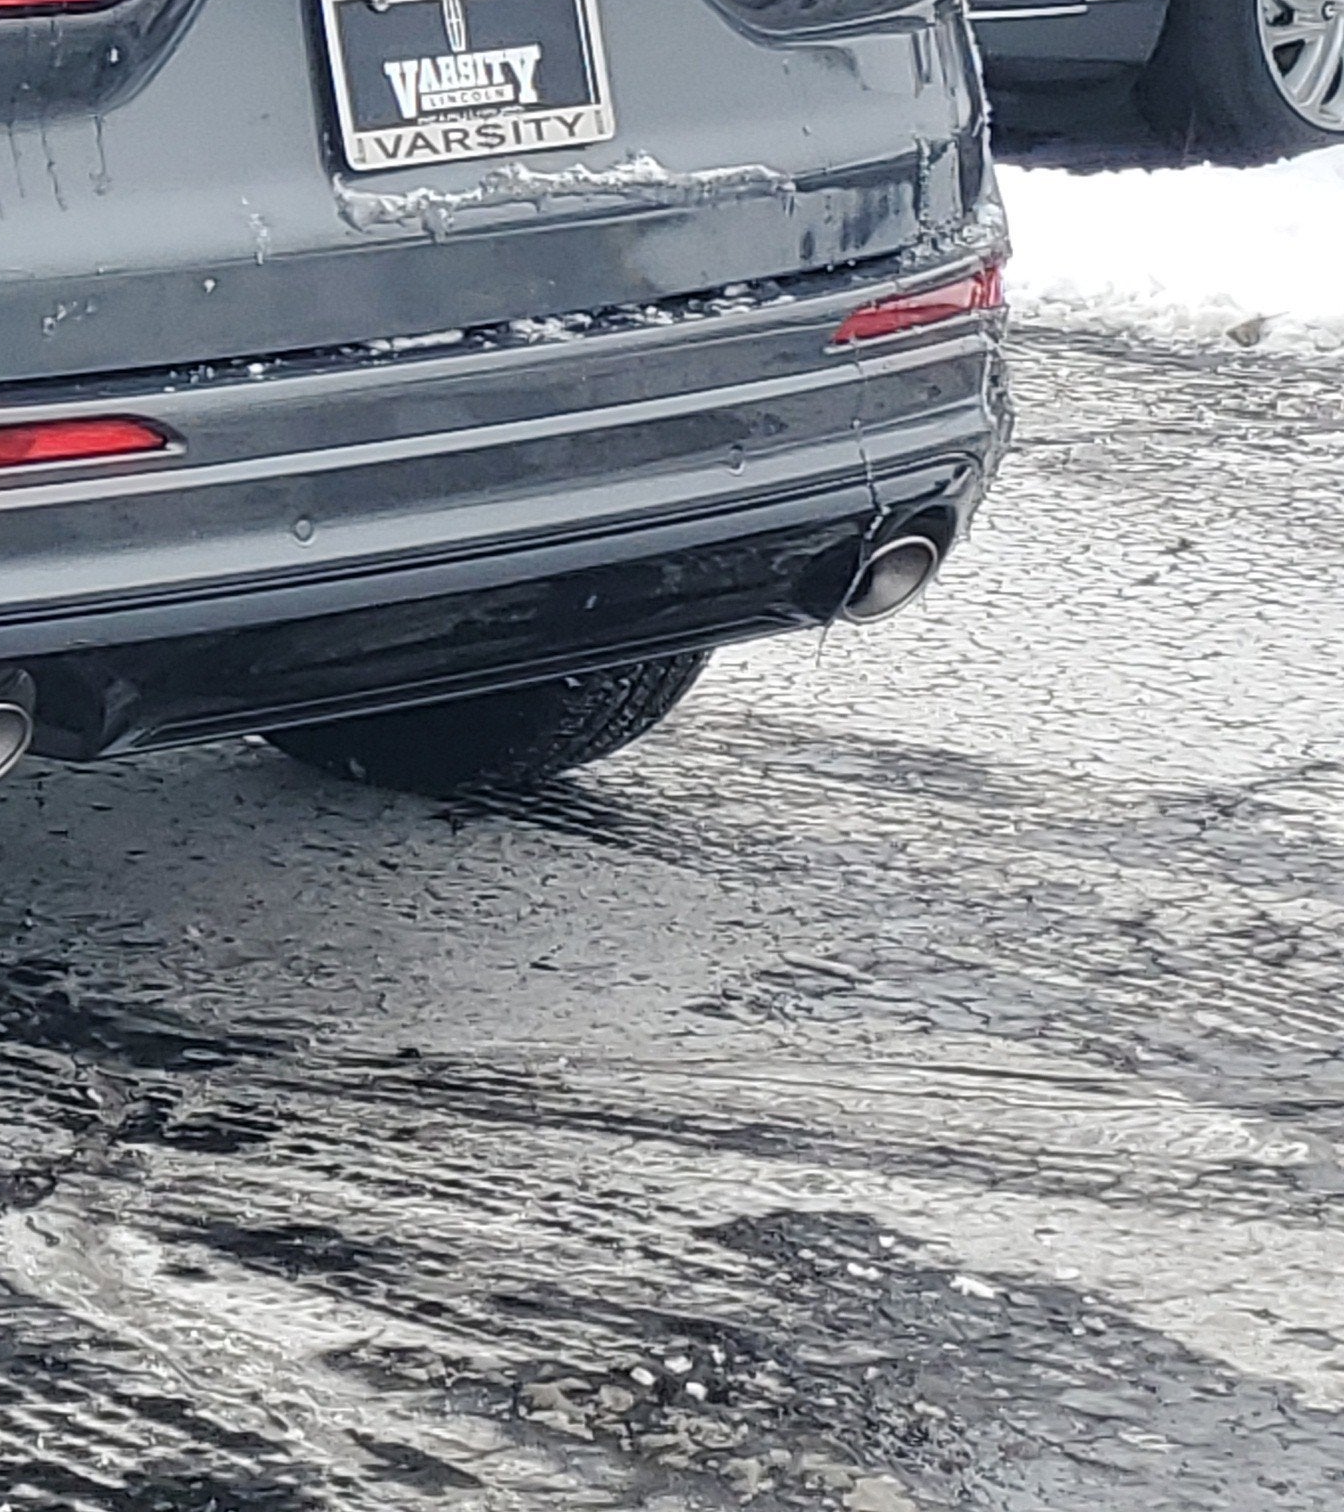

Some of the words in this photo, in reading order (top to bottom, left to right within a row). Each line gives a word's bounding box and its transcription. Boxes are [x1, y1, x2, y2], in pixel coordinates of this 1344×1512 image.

[384, 44, 541, 119] VARSITY
[429, 88, 506, 107] LINCOLN
[374, 112, 584, 159] VARSITY
